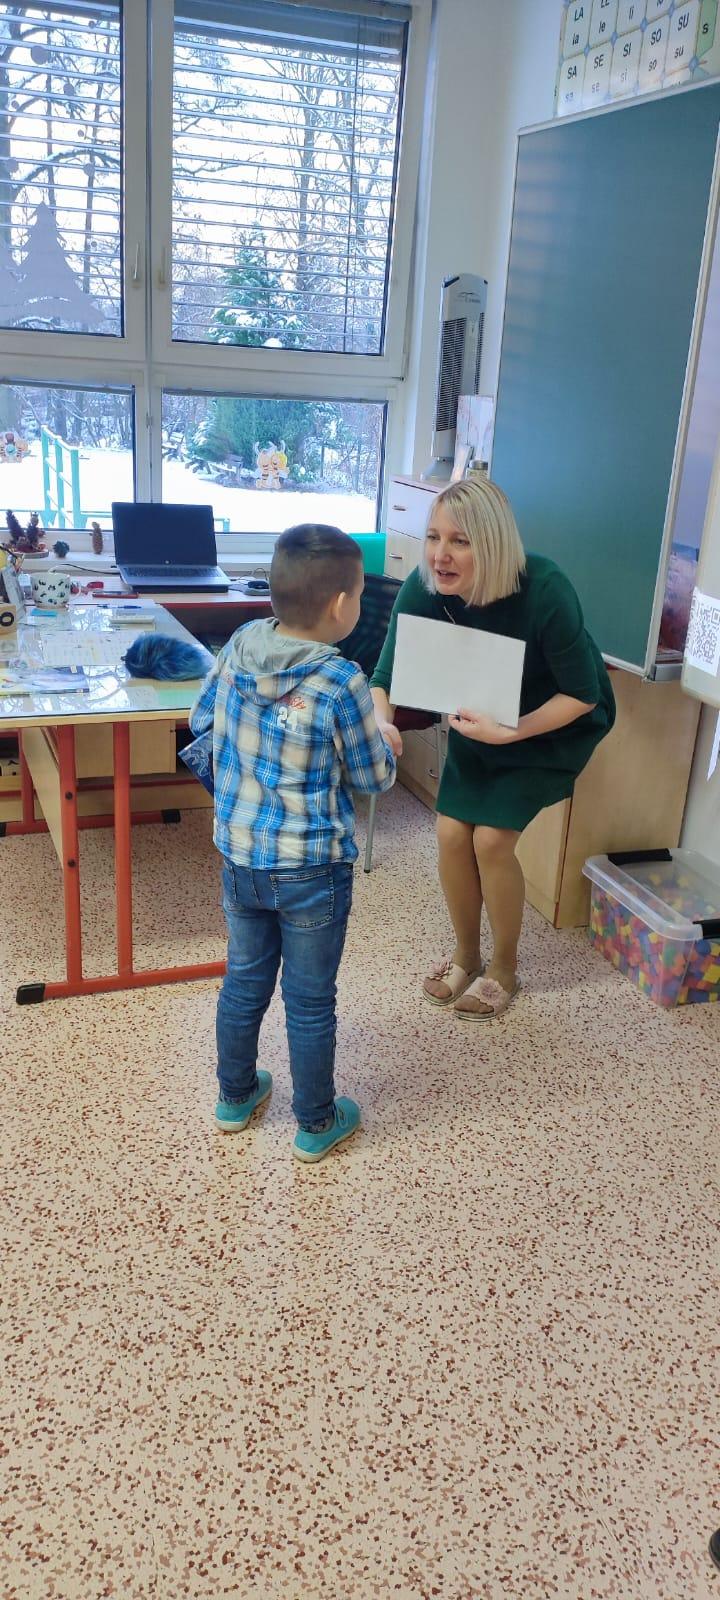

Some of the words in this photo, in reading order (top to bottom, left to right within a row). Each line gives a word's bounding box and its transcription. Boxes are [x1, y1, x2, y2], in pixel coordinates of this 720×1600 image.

[574, 7, 584, 22] LA
[567, 65, 577, 80] SA
[593, 54, 604, 70] SE
[623, 43, 632, 57] SI
[650, 28, 662, 46] SO
[677, 12, 690, 32] SU
[591, 82, 600, 94] se
[674, 45, 684, 59] su
